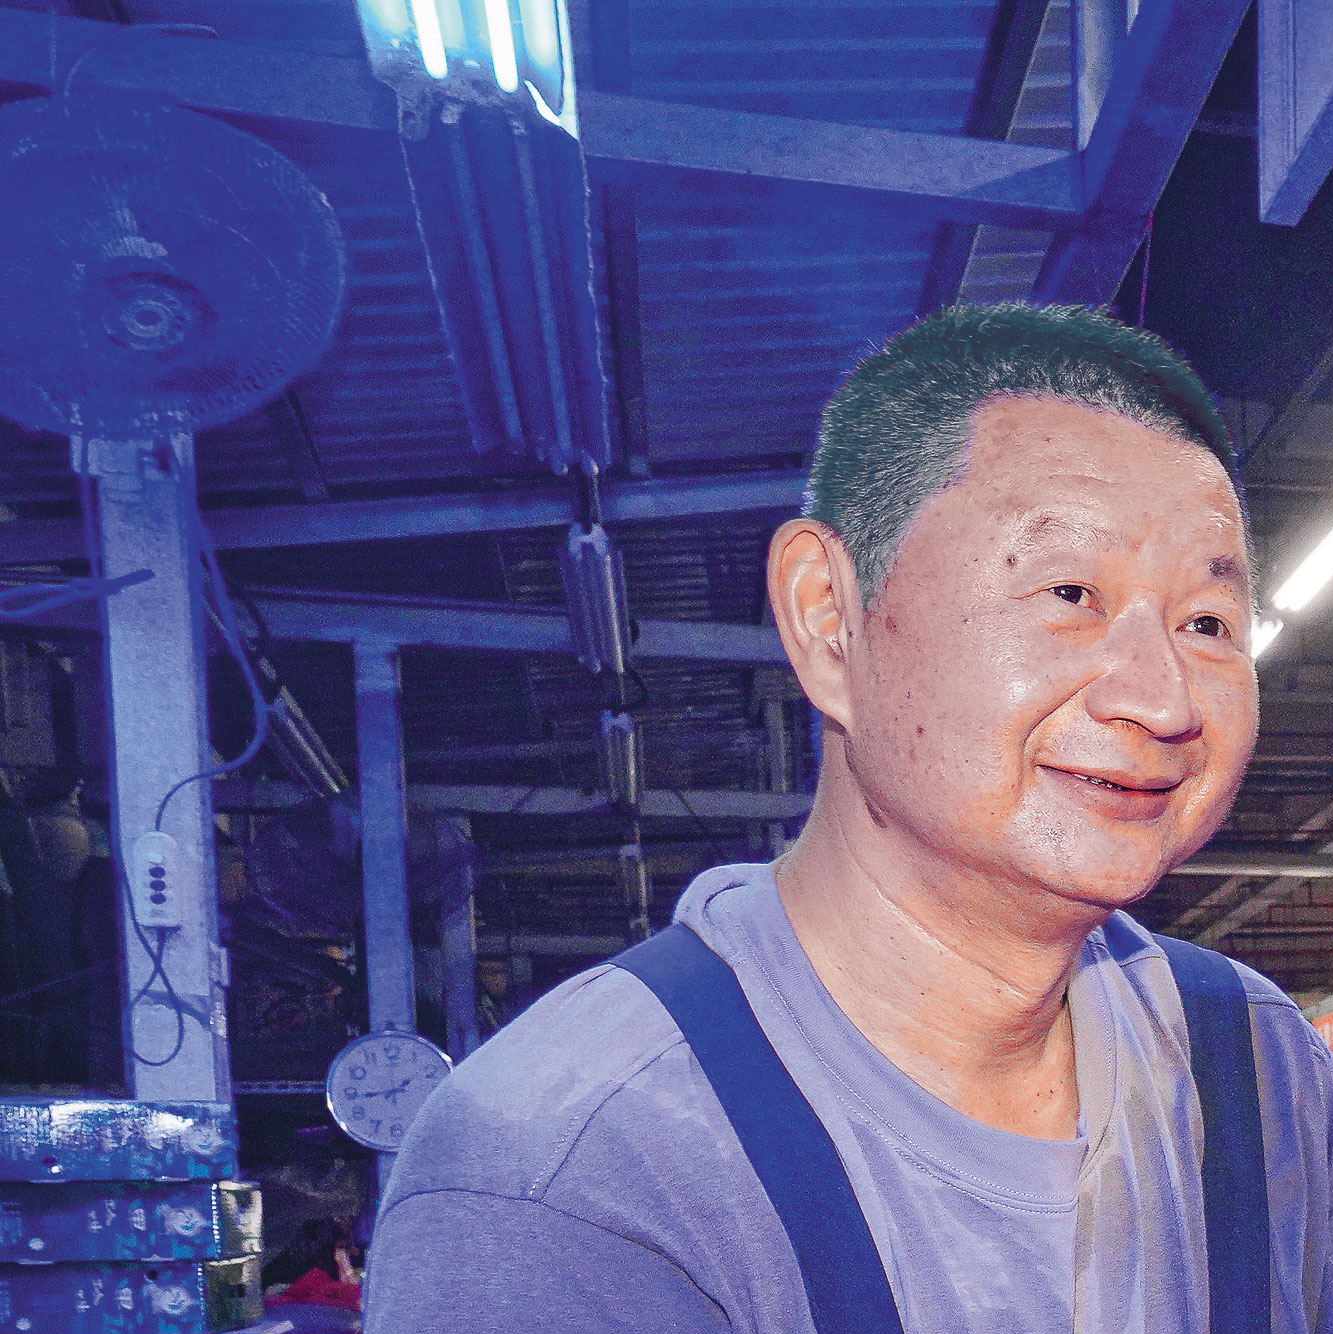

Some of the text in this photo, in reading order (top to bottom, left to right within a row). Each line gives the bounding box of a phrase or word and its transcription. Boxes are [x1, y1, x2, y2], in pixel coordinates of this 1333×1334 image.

[349, 1066, 367, 1081] 10
[370, 1120, 383, 1133] 7
[390, 1123, 404, 1138] 6
